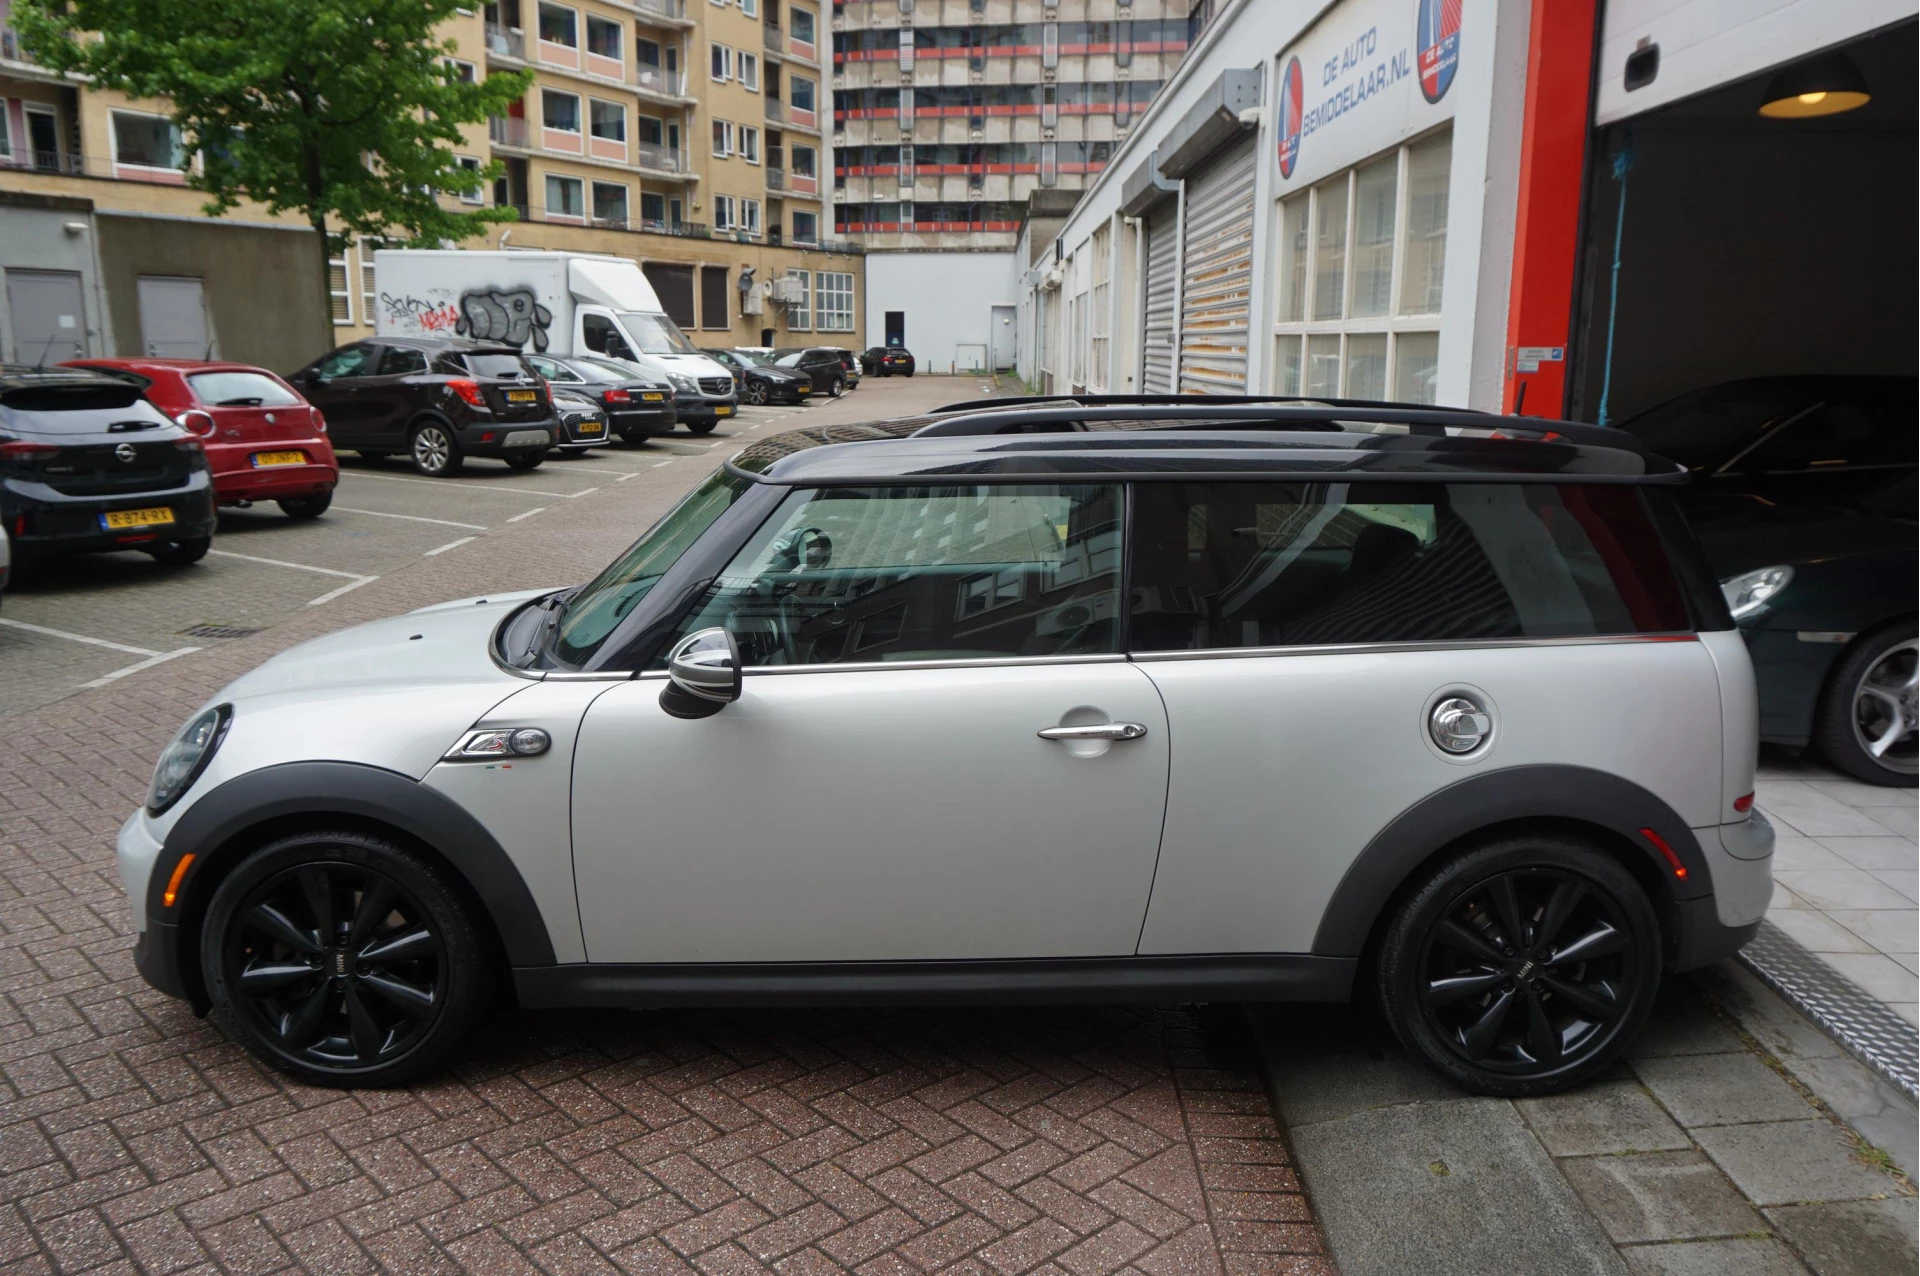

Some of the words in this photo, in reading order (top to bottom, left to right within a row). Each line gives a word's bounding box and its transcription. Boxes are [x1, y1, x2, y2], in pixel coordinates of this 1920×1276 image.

[1323, 54, 1339, 88] DE
[1341, 26, 1377, 75] AUTO
[1303, 48, 1411, 137] BEMIDDELAAR.NL
[110, 508, 170, 526] R-874-RX
[336, 954, 345, 973] MINI
[1516, 960, 1534, 979] MINI
